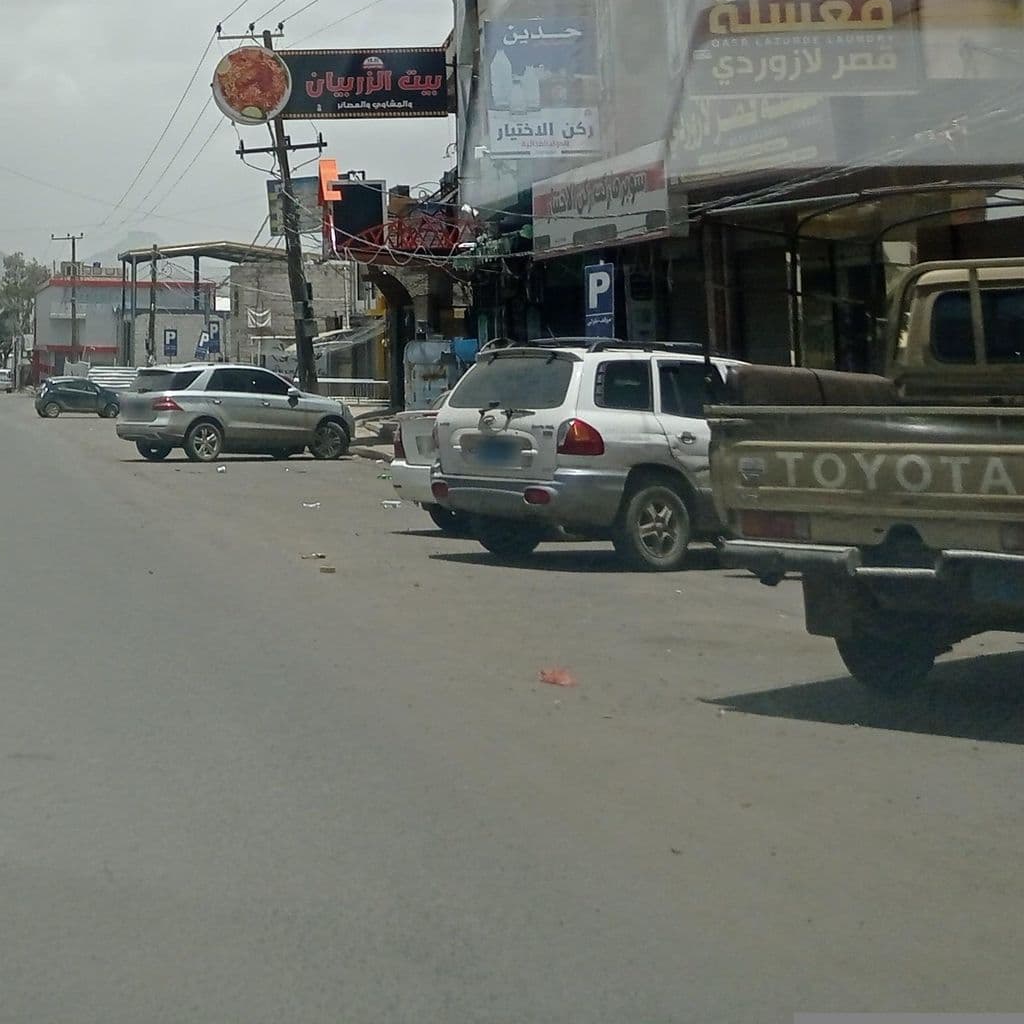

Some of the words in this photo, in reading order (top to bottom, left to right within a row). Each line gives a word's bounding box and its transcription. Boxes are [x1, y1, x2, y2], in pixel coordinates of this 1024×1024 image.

[711, 47, 823, 86] لازوردي
[831, 45, 897, 80] قصر
[305, 69, 393, 98] الزربيان
[398, 69, 442, 96] بيت
[372, 100, 413, 110] والمشاوي
[496, 122, 554, 142] الاختيار
[562, 121, 594, 139] ركن
[589, 272, 611, 309] P
[165, 331, 176, 345] P
[199, 332, 210, 347] P
[210, 323, 219, 339] P
[776, 451, 1018, 495] TOYOTA
